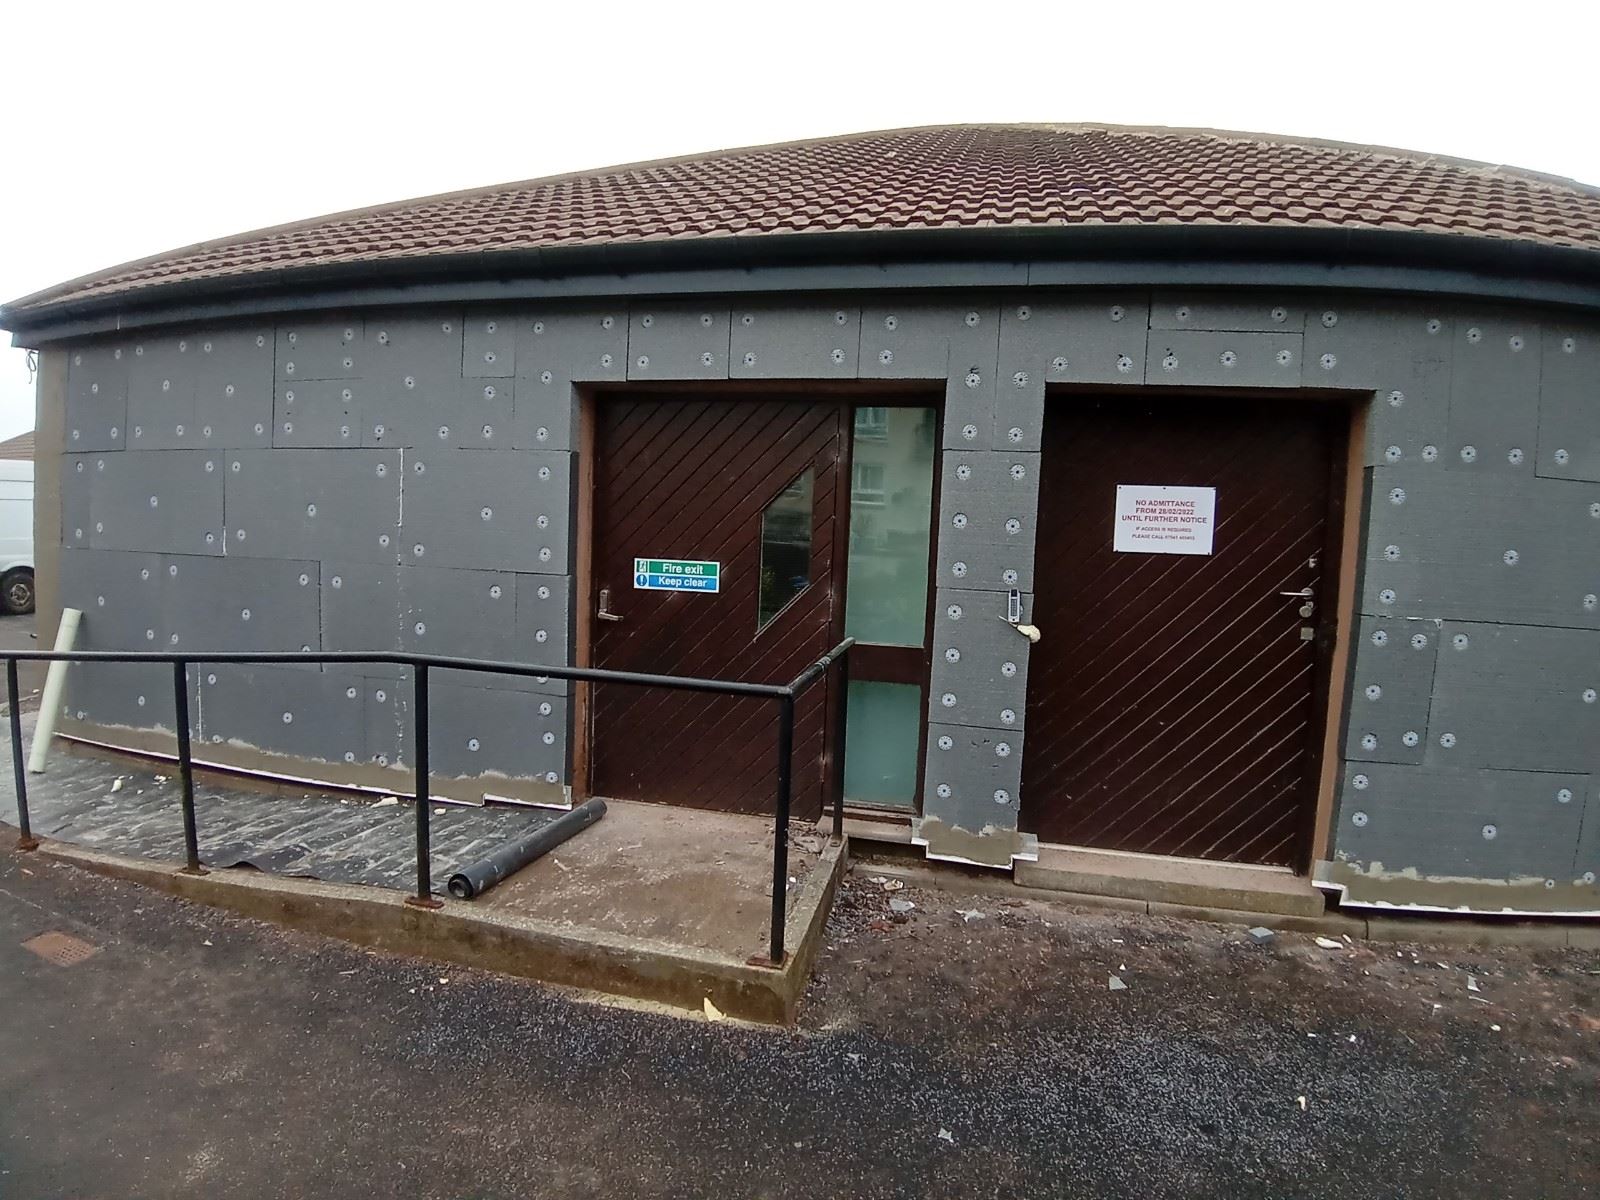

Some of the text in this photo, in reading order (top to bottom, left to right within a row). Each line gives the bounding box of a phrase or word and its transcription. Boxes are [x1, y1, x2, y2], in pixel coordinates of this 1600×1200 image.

[1148, 500, 1196, 508] ADMITTANCE
[1144, 515, 1179, 523] FURTHER
[1179, 516, 1208, 524] NOTICE
[662, 563, 704, 575] Fire exit
[658, 576, 708, 588] Keep clear
